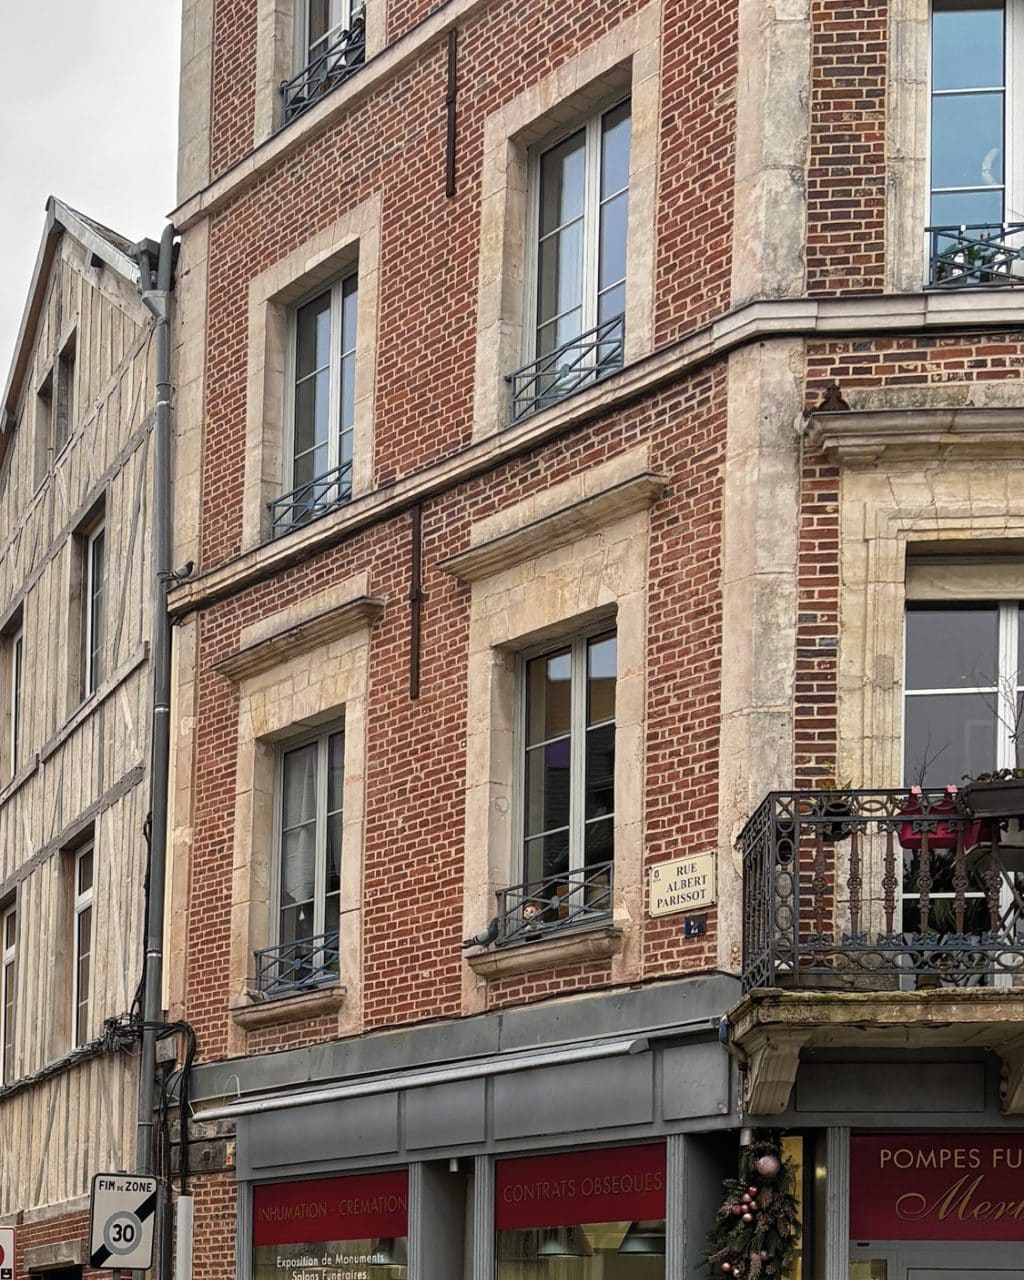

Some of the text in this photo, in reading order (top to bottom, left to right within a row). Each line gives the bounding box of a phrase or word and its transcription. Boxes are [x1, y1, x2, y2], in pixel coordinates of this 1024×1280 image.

[676, 863, 697, 876] RUE
[666, 874, 707, 893] ALBERT
[657, 889, 707, 909] PARISSOT
[880, 1148, 981, 1169] POMPES
[125, 1181, 153, 1193] ZONE
[503, 1172, 663, 1203] CONTRATS OBSEQUES
[258, 1202, 327, 1222] INHUMATION
[112, 1223, 135, 1243] 30
[276, 1253, 385, 1270] Exposition de Monuments
[322, 1269, 367, 1280] Funéraires
